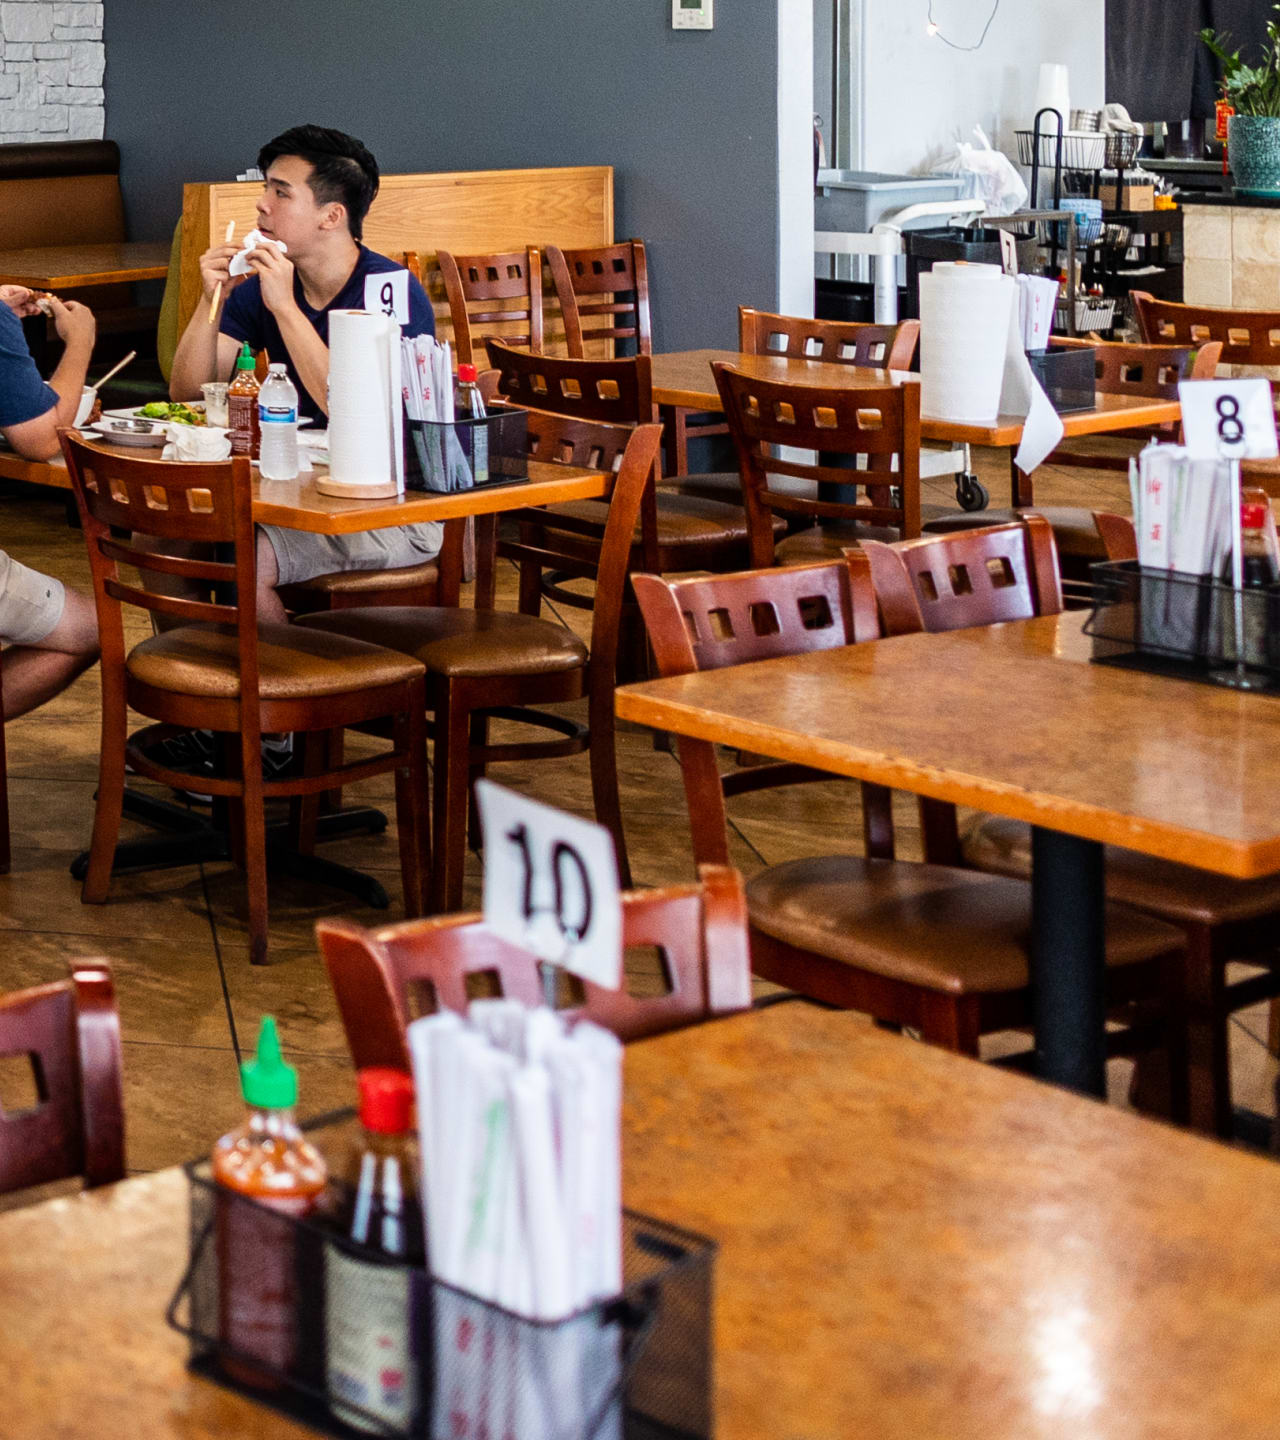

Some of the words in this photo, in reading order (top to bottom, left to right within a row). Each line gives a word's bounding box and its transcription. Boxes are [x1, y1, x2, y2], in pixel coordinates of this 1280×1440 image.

[380, 282, 394, 316] 9
[1216, 395, 1244, 444] 8
[506, 822, 592, 940] 10
